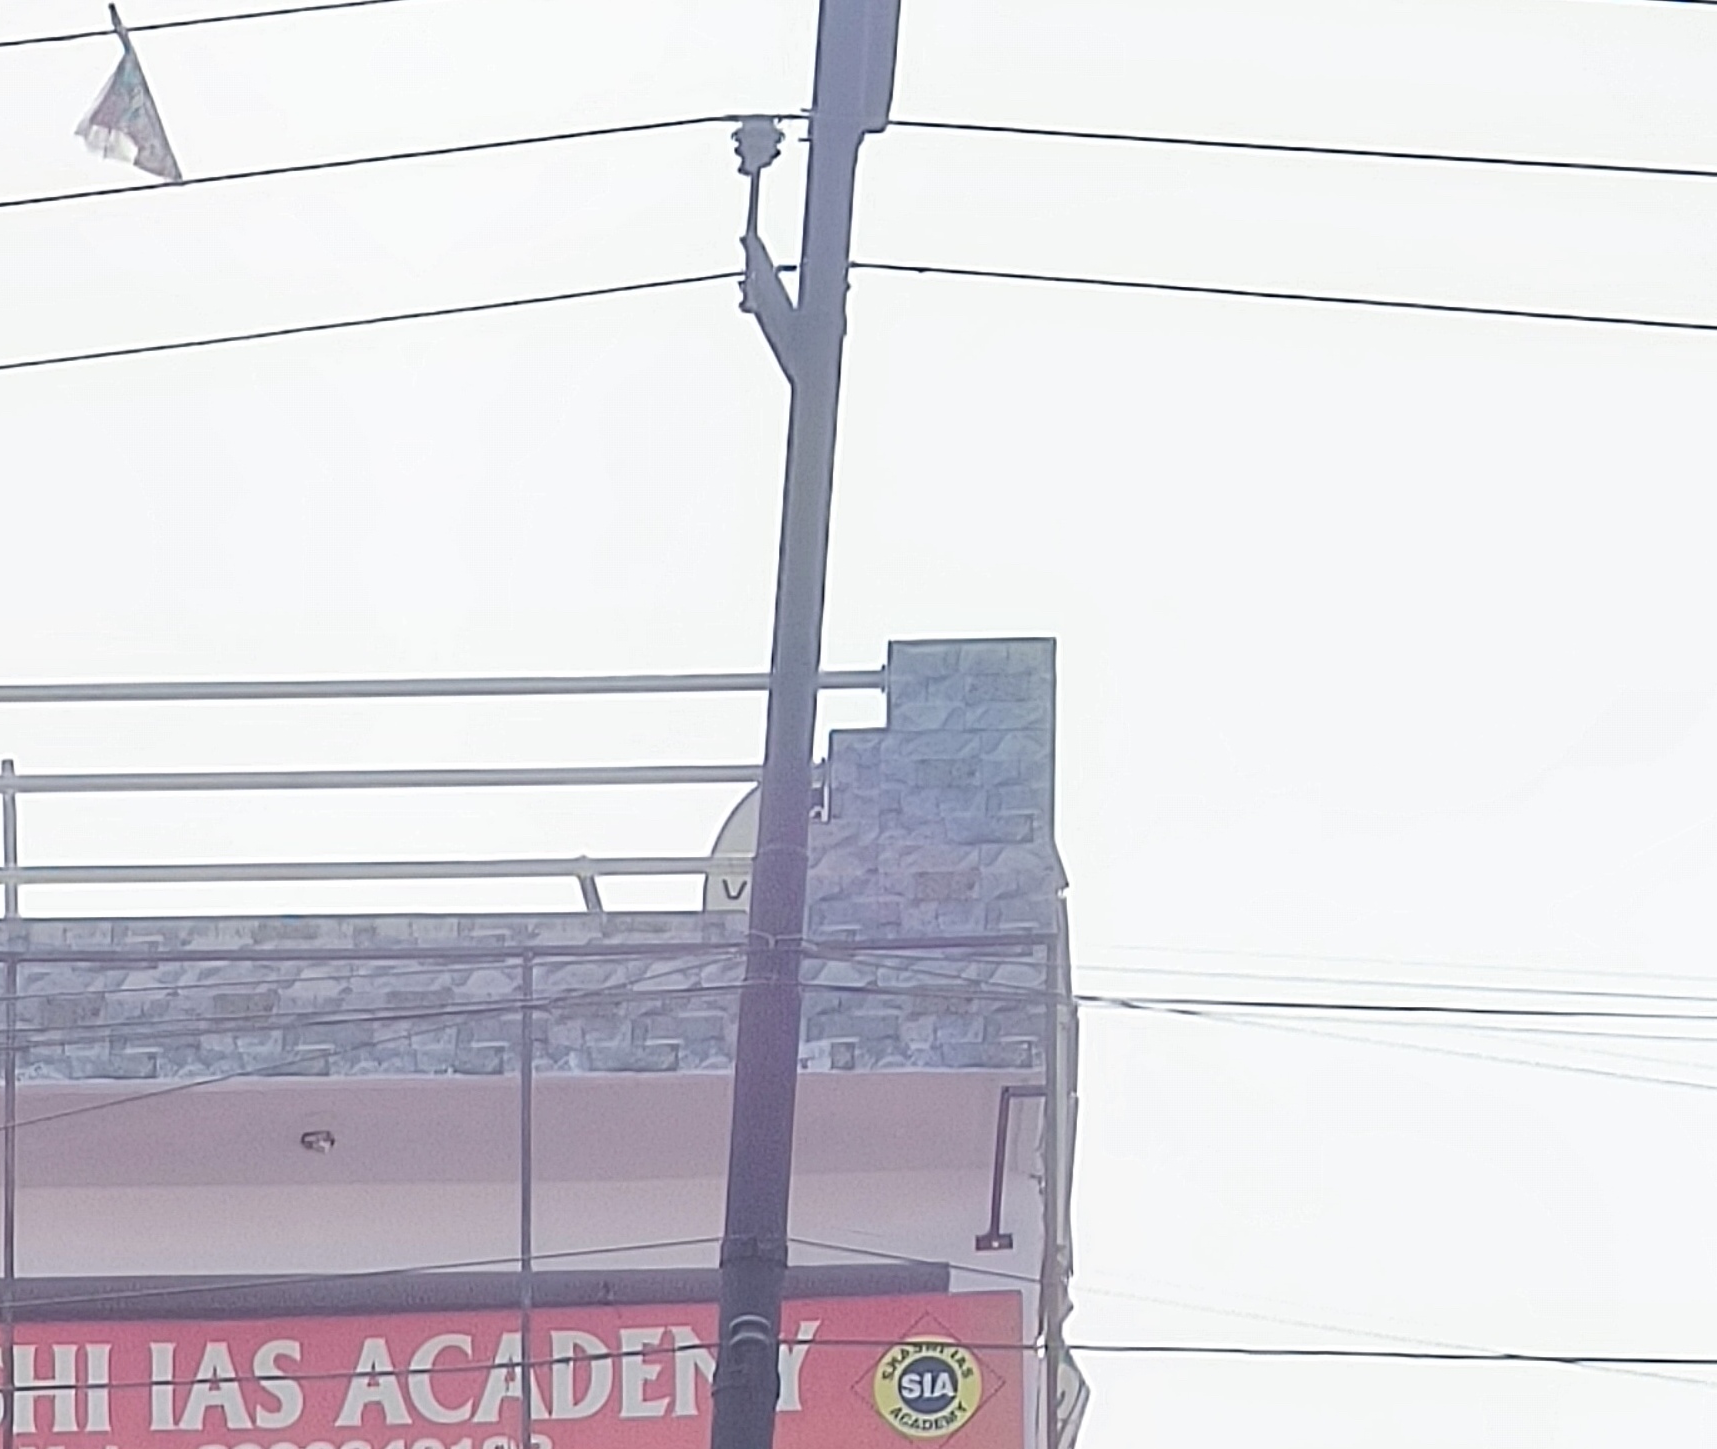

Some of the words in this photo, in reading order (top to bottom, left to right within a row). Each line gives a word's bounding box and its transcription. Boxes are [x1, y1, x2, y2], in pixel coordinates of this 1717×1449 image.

[149, 1338, 305, 1432] IAS
[901, 1372, 956, 1398] SIA
[890, 1400, 967, 1431] ACADEMY
